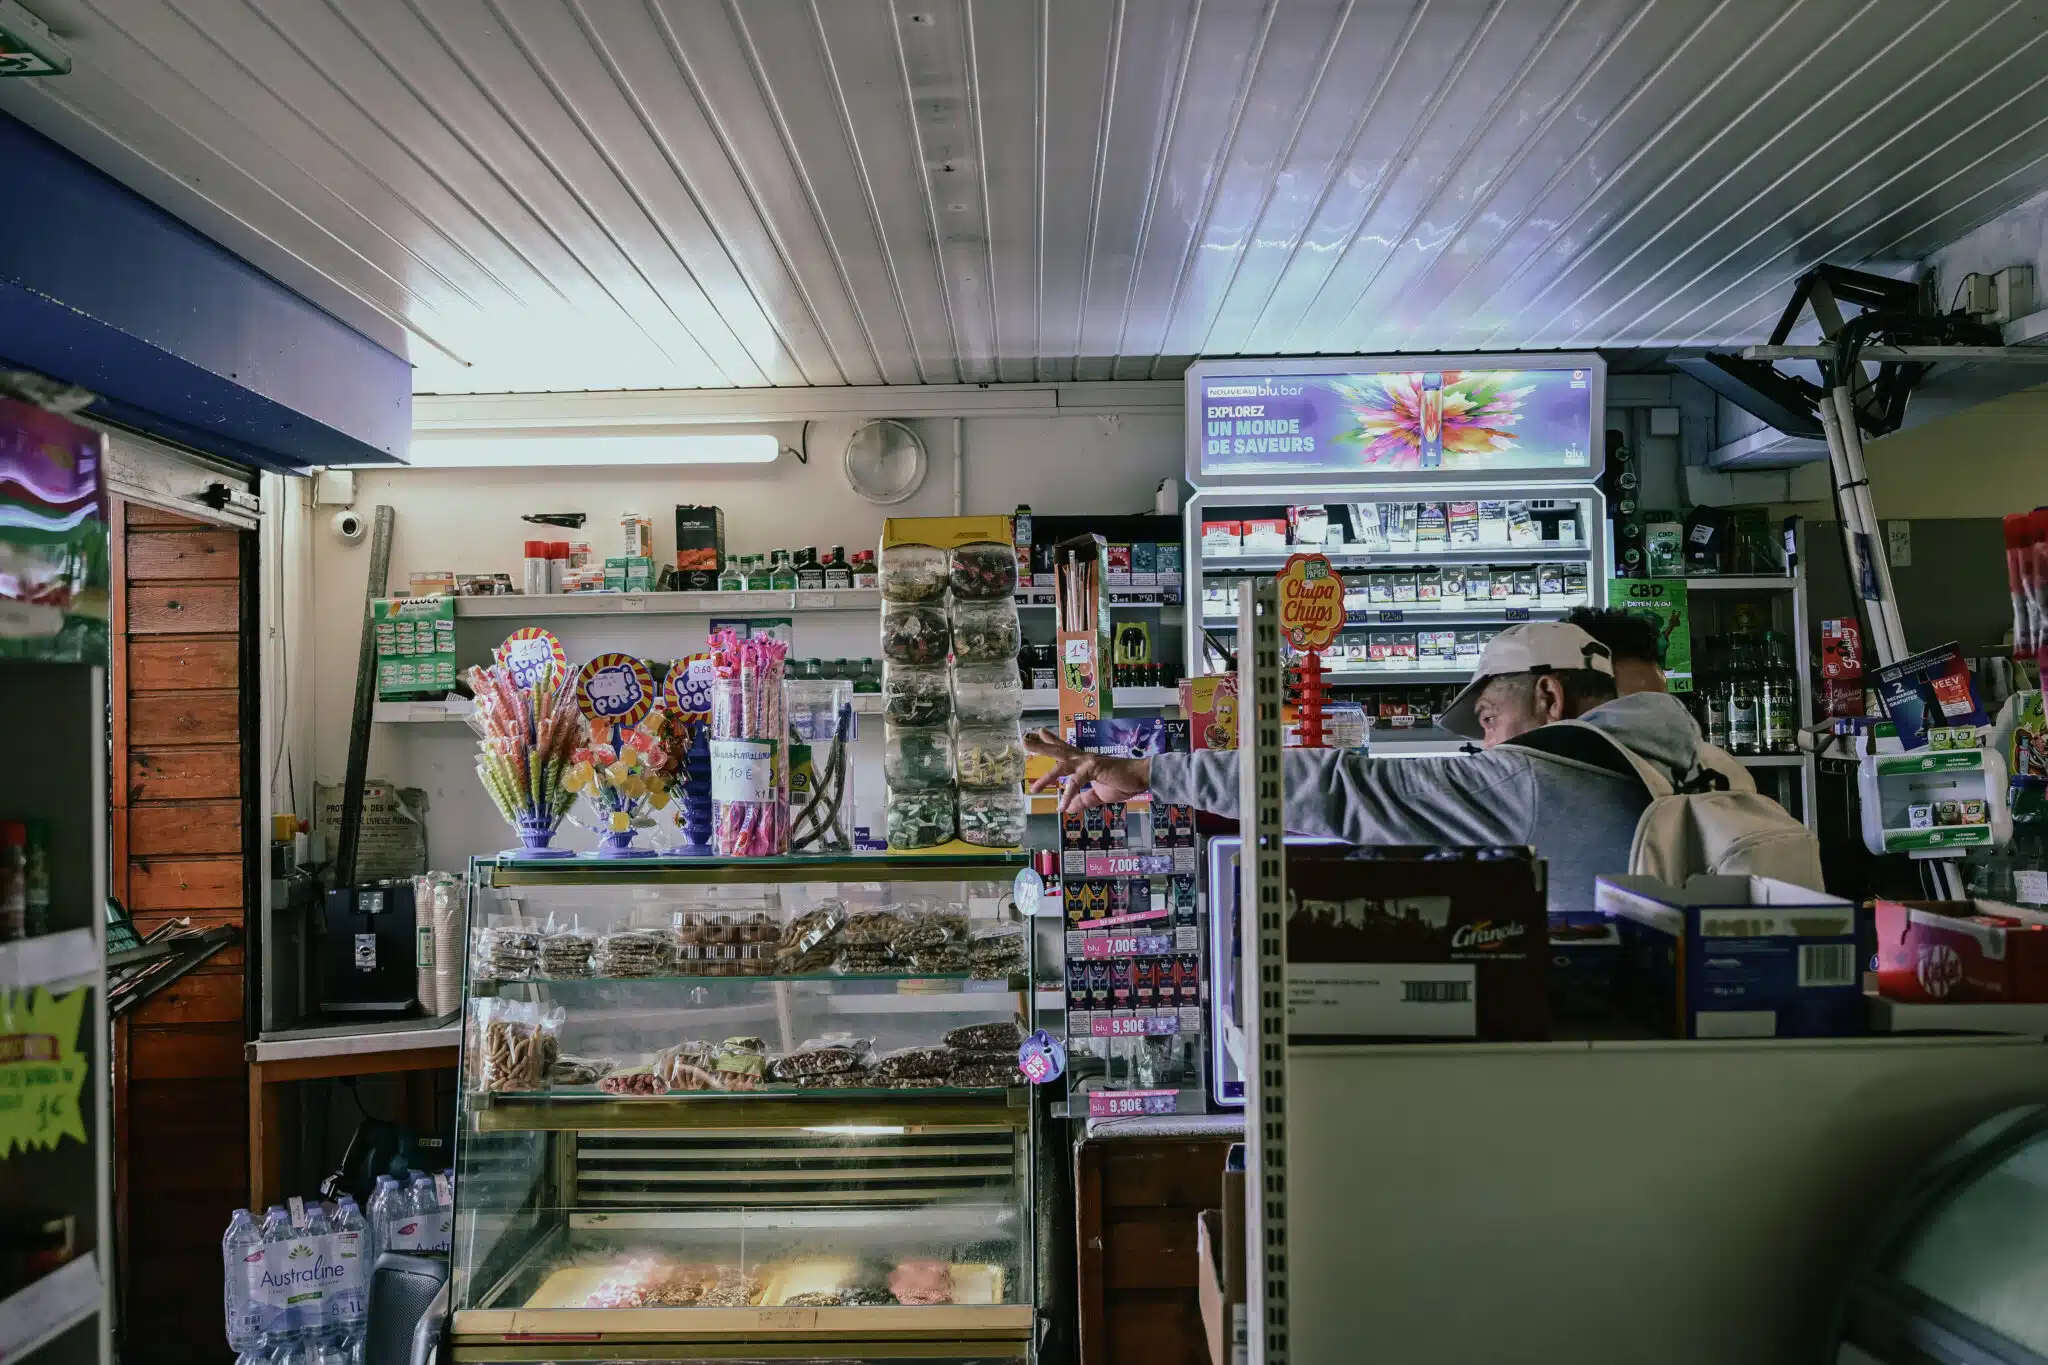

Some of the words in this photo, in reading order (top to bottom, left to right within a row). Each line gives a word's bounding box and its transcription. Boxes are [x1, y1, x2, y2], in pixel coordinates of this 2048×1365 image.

[1209, 389, 1256, 397] NOUVEAU
[1281, 385, 1304, 396] bar
[1207, 405, 1265, 418] EXPLOREZ
[1207, 421, 1233, 437] UN
[1236, 419, 1300, 436] MONDE
[1208, 439, 1231, 455] DE
[1234, 436, 1315, 454] SAVEURS
[1286, 579, 1335, 604] Chupa
[1629, 583, 1664, 598] CBD
[1284, 600, 1333, 625] Chups
[1673, 680, 1689, 690] ICI
[1892, 682, 1905, 694] 2
[1931, 676, 1959, 690] VEEV
[1887, 689, 1917, 702] RECHARGES
[370, 804, 384, 812] DES
[1089, 863, 1104, 871] blu
[1109, 858, 1140, 874] 7,00€
[1087, 944, 1101, 952] blu
[1106, 939, 1137, 955] 7,00€
[1095, 1024, 1109, 1032] blu
[1112, 1018, 1145, 1035] 9,90€
[1092, 1104, 1106, 1113] blu
[1109, 1098, 1143, 1114] 9,90€
[260, 1254, 345, 1288] Australine
